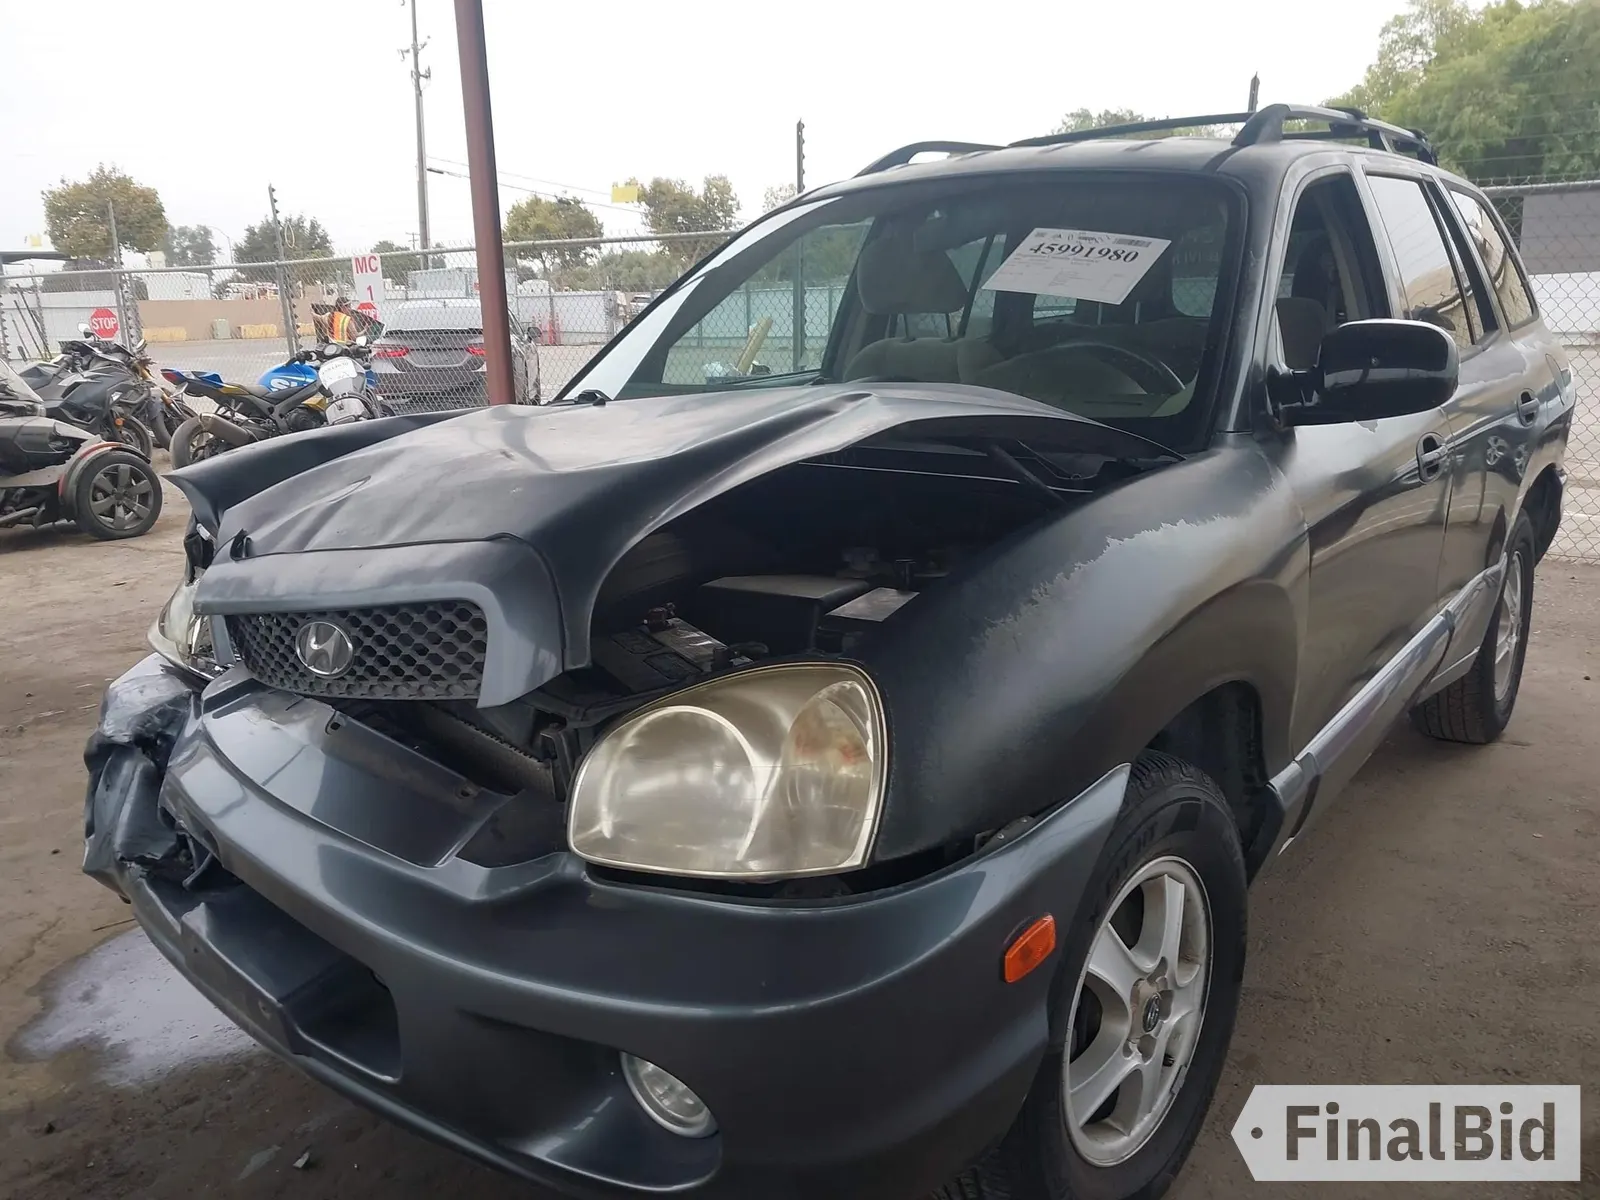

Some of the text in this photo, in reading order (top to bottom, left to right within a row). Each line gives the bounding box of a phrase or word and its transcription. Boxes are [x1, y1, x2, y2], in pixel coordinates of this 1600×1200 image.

[1029, 241, 1139, 263] 45991980
[354, 255, 378, 274] MC
[366, 285, 374, 301] 1
[92, 317, 117, 330] STOP
